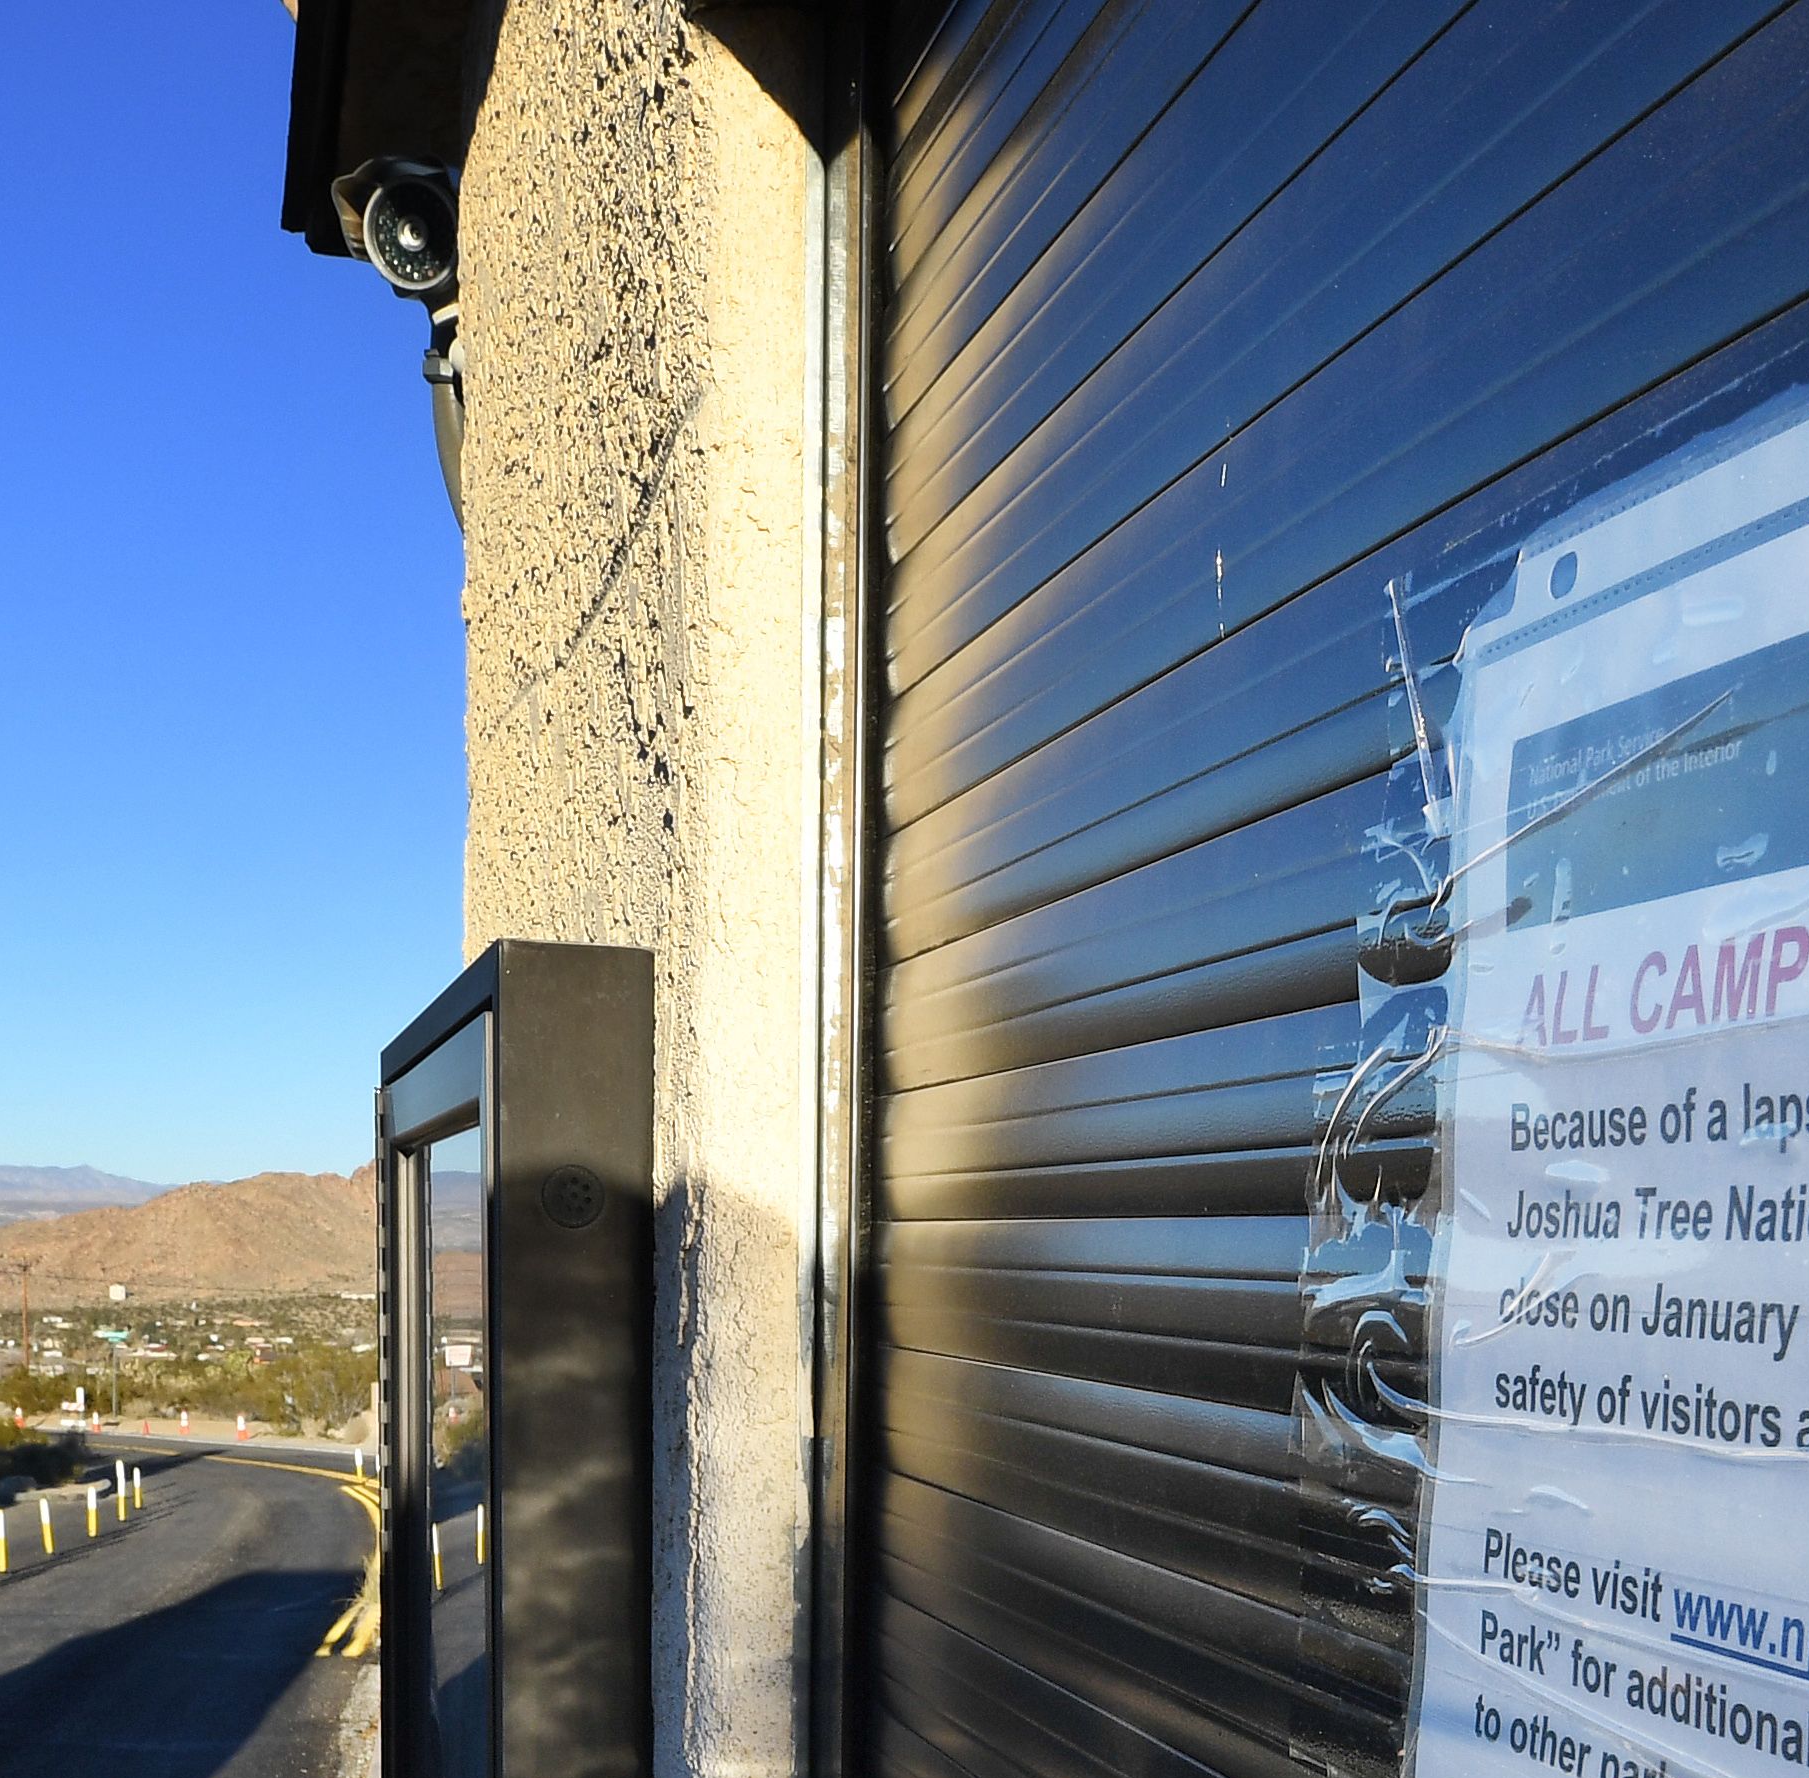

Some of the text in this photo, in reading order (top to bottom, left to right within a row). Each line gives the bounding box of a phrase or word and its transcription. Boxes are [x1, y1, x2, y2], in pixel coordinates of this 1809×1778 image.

[1528, 752, 1583, 787] National
[1586, 742, 1614, 769] Park
[1635, 740, 1743, 788] of the Interior
[1515, 962, 1610, 1048] ALL
[1510, 1091, 1646, 1152] Because
[1659, 1086, 1702, 1145] of
[1705, 1101, 1729, 1142] a
[1506, 1189, 1621, 1240] Joshua
[1634, 1187, 1713, 1243] Tree
[1498, 1278, 1580, 1331] close
[1589, 1290, 1631, 1335] on
[1640, 1283, 1799, 1363] January
[1493, 1366, 1586, 1428] safety
[1595, 1366, 1634, 1428] of
[1640, 1379, 1782, 1449] visitors
[1482, 1527, 1581, 1599] Please
[1591, 1562, 1664, 1622] visit
[1479, 1608, 1561, 1676] Park”
[1570, 1637, 1617, 1698] for
[1474, 1692, 1502, 1743] to
